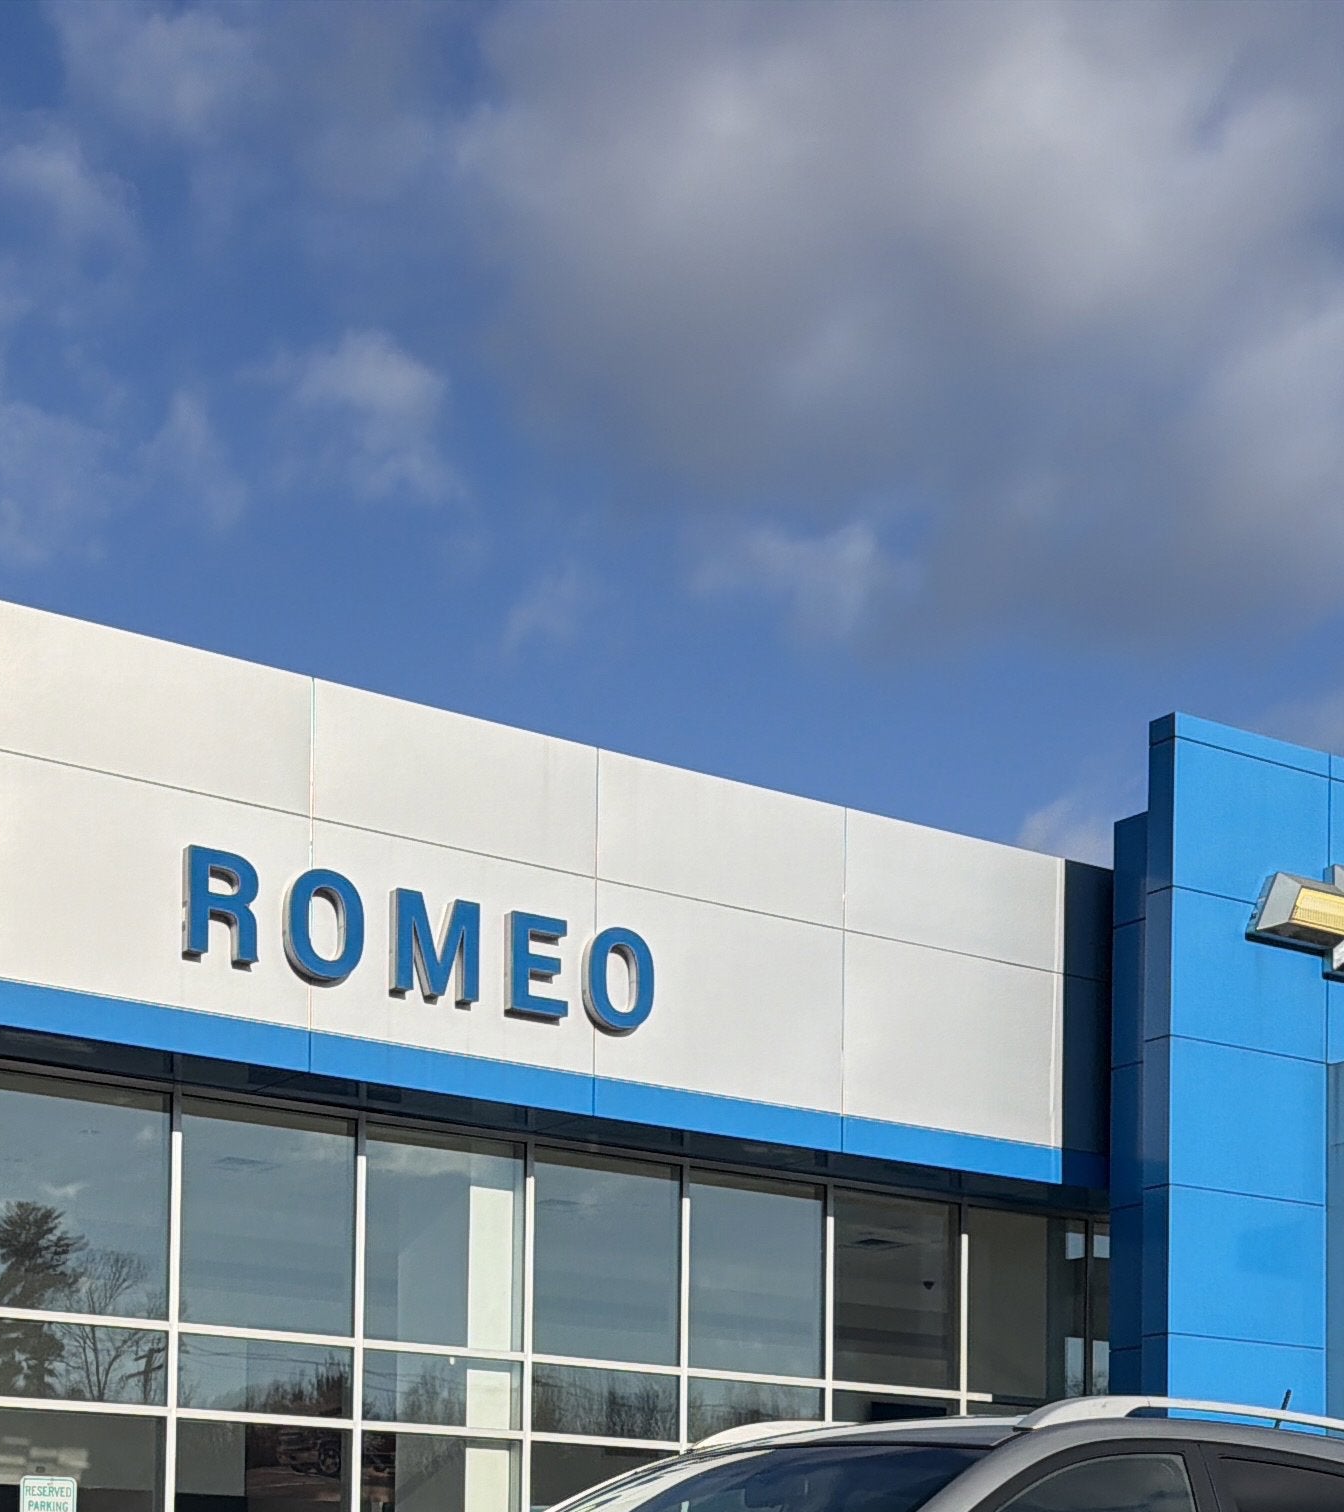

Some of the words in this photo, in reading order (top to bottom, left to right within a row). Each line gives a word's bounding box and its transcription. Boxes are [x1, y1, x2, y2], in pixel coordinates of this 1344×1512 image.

[183, 844, 655, 1036] ROMEO
[25, 1485, 72, 1498] RESERVED
[27, 1500, 69, 1512] PARKING
